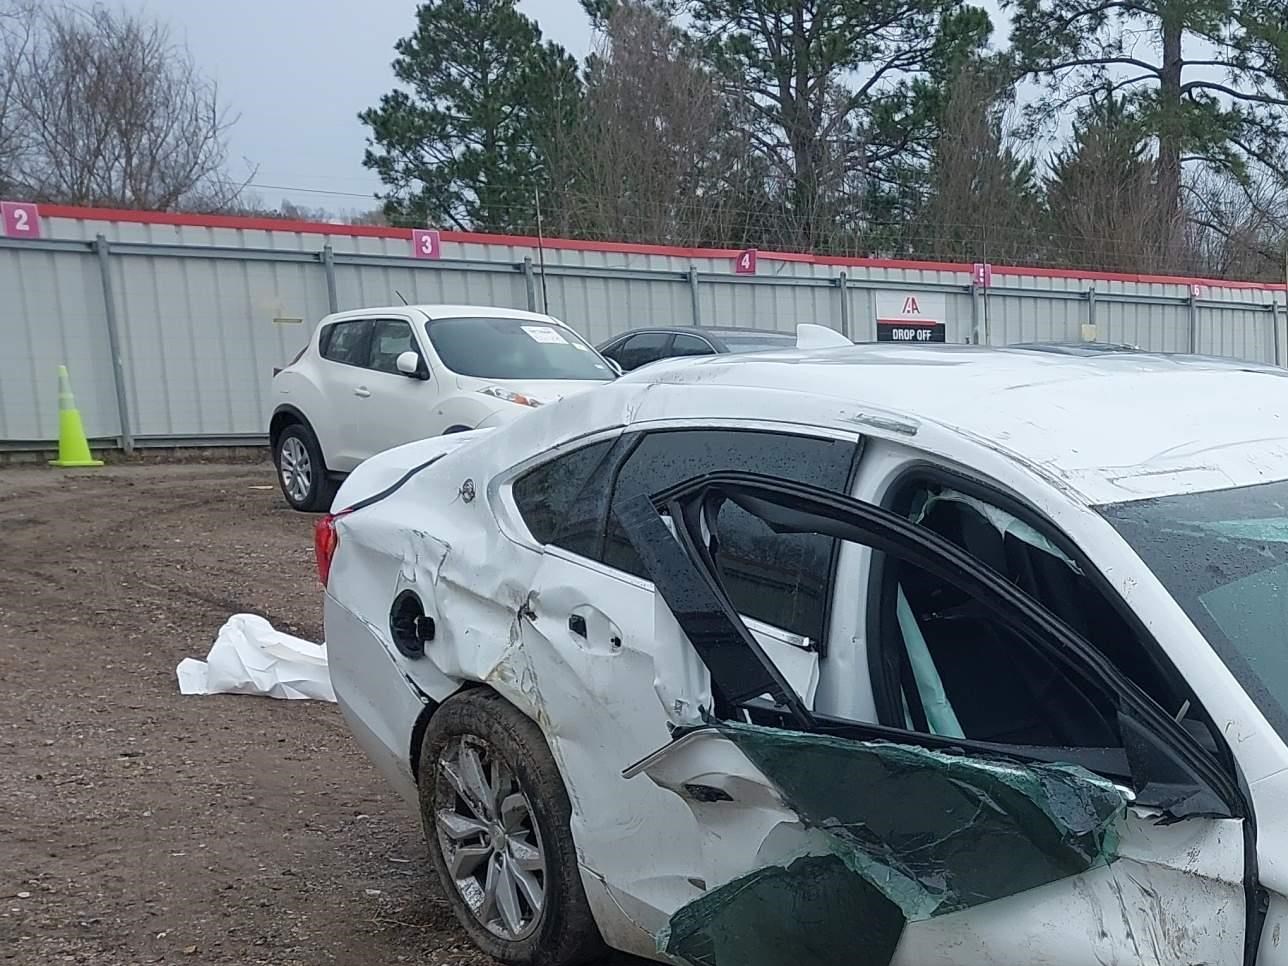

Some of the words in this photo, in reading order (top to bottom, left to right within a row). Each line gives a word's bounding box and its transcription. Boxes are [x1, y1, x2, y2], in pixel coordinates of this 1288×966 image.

[14, 208, 30, 231] 2
[421, 235, 432, 254] 3
[741, 253, 750, 269] 4
[892, 329, 915, 340] DROP
[917, 330, 932, 341] OFF
